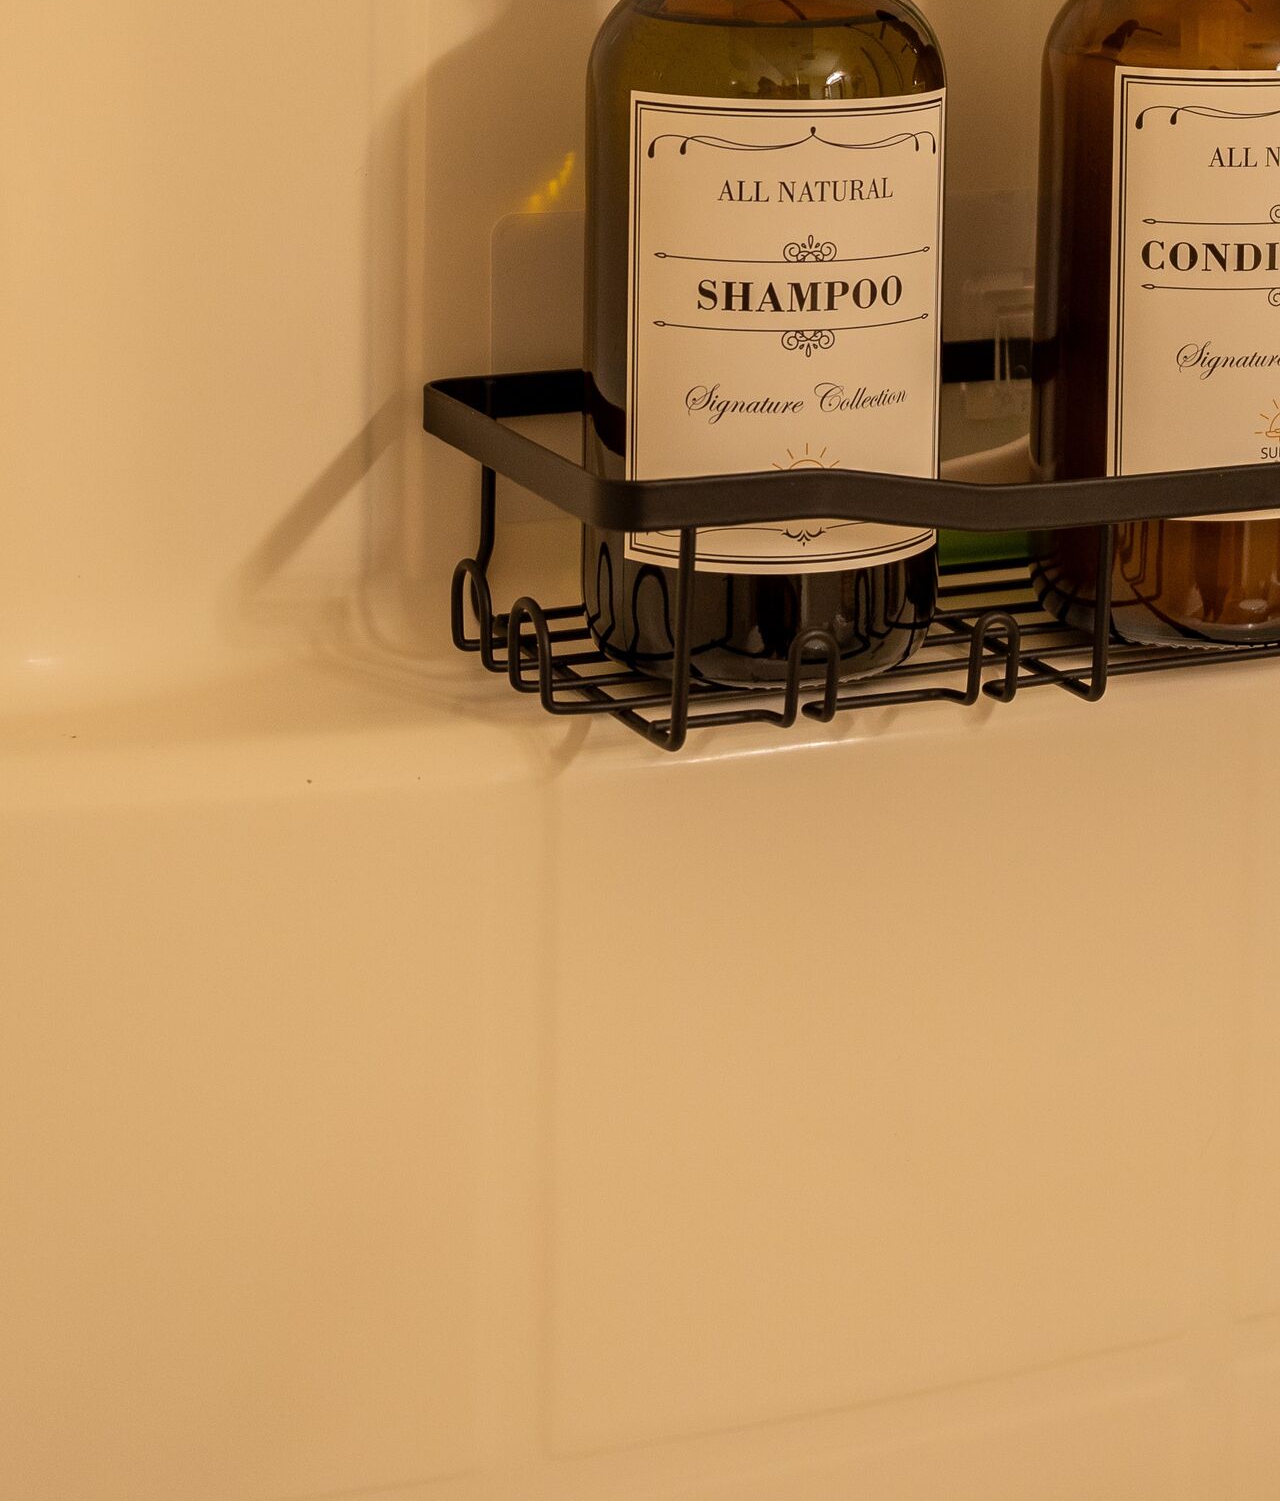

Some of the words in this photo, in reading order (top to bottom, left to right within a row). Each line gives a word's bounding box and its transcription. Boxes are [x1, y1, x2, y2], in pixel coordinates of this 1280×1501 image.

[1207, 146, 1258, 169] ALL
[716, 179, 771, 204] ALL
[777, 176, 894, 203] NATURAL
[696, 274, 903, 313] SHAMPOO
[684, 382, 804, 425] Signature
[813, 382, 908, 413] Collection
